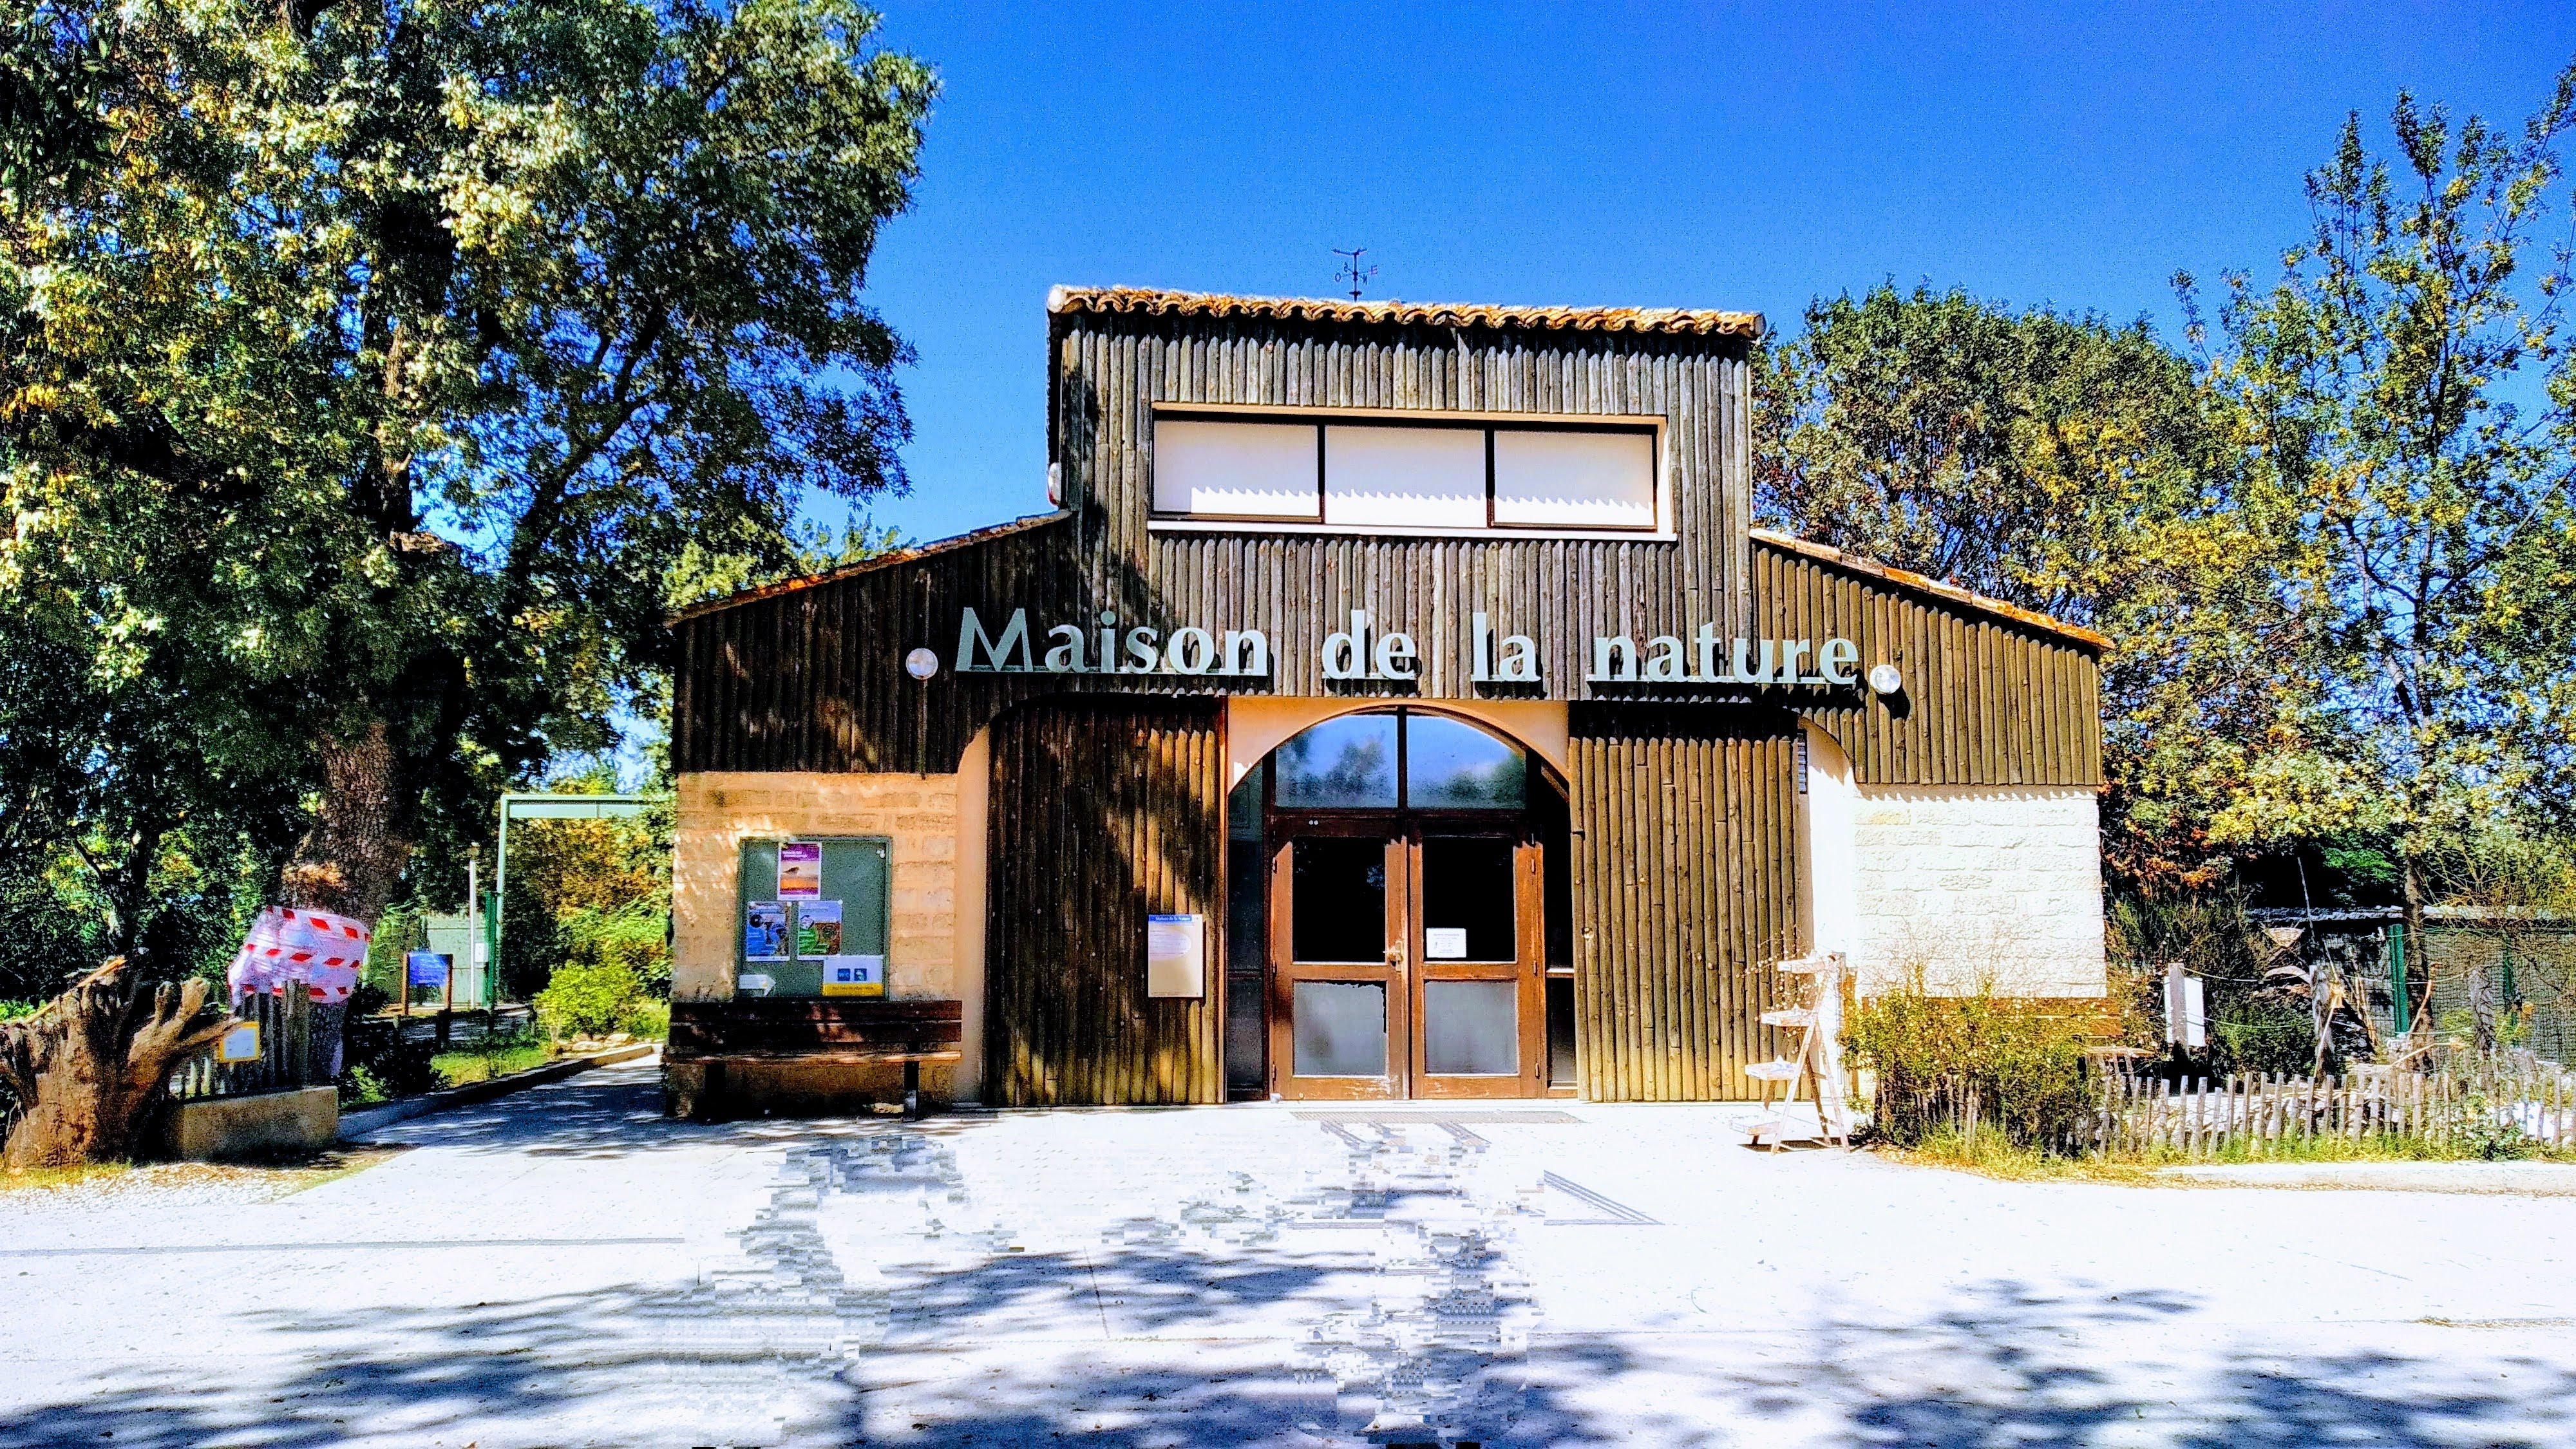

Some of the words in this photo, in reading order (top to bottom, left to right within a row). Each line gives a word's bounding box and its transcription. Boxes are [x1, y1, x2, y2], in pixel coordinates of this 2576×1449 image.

[1370, 265, 1378, 276] E
[1334, 272, 1341, 282] O
[955, 606, 1269, 676] Maison
[1321, 609, 1417, 680] de
[1471, 612, 1541, 682] la
[1591, 622, 1859, 684] nature
